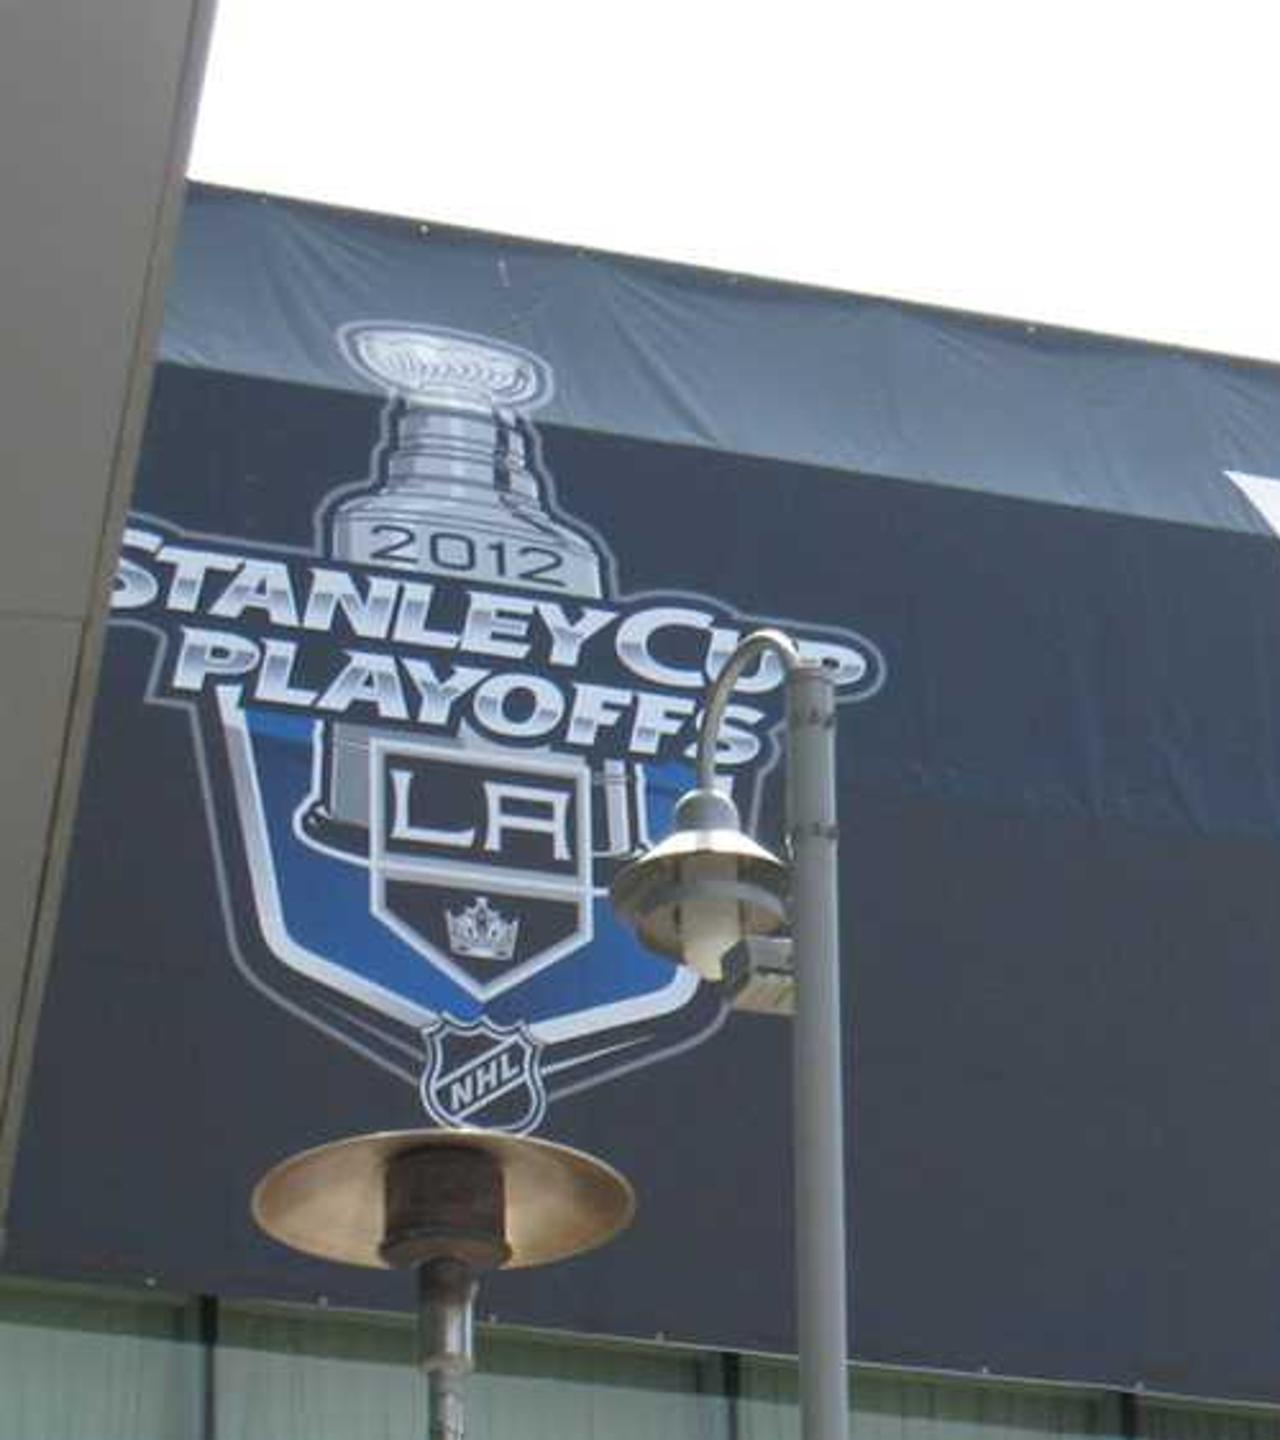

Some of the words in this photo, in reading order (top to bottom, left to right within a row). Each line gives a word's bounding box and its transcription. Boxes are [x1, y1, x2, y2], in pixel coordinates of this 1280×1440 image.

[108, 526, 620, 665] STANLEY
[368, 522, 569, 590] 2012
[171, 624, 762, 766] PLAYOFFS
[389, 768, 573, 861] LA
[449, 1052, 521, 1112] NHL
